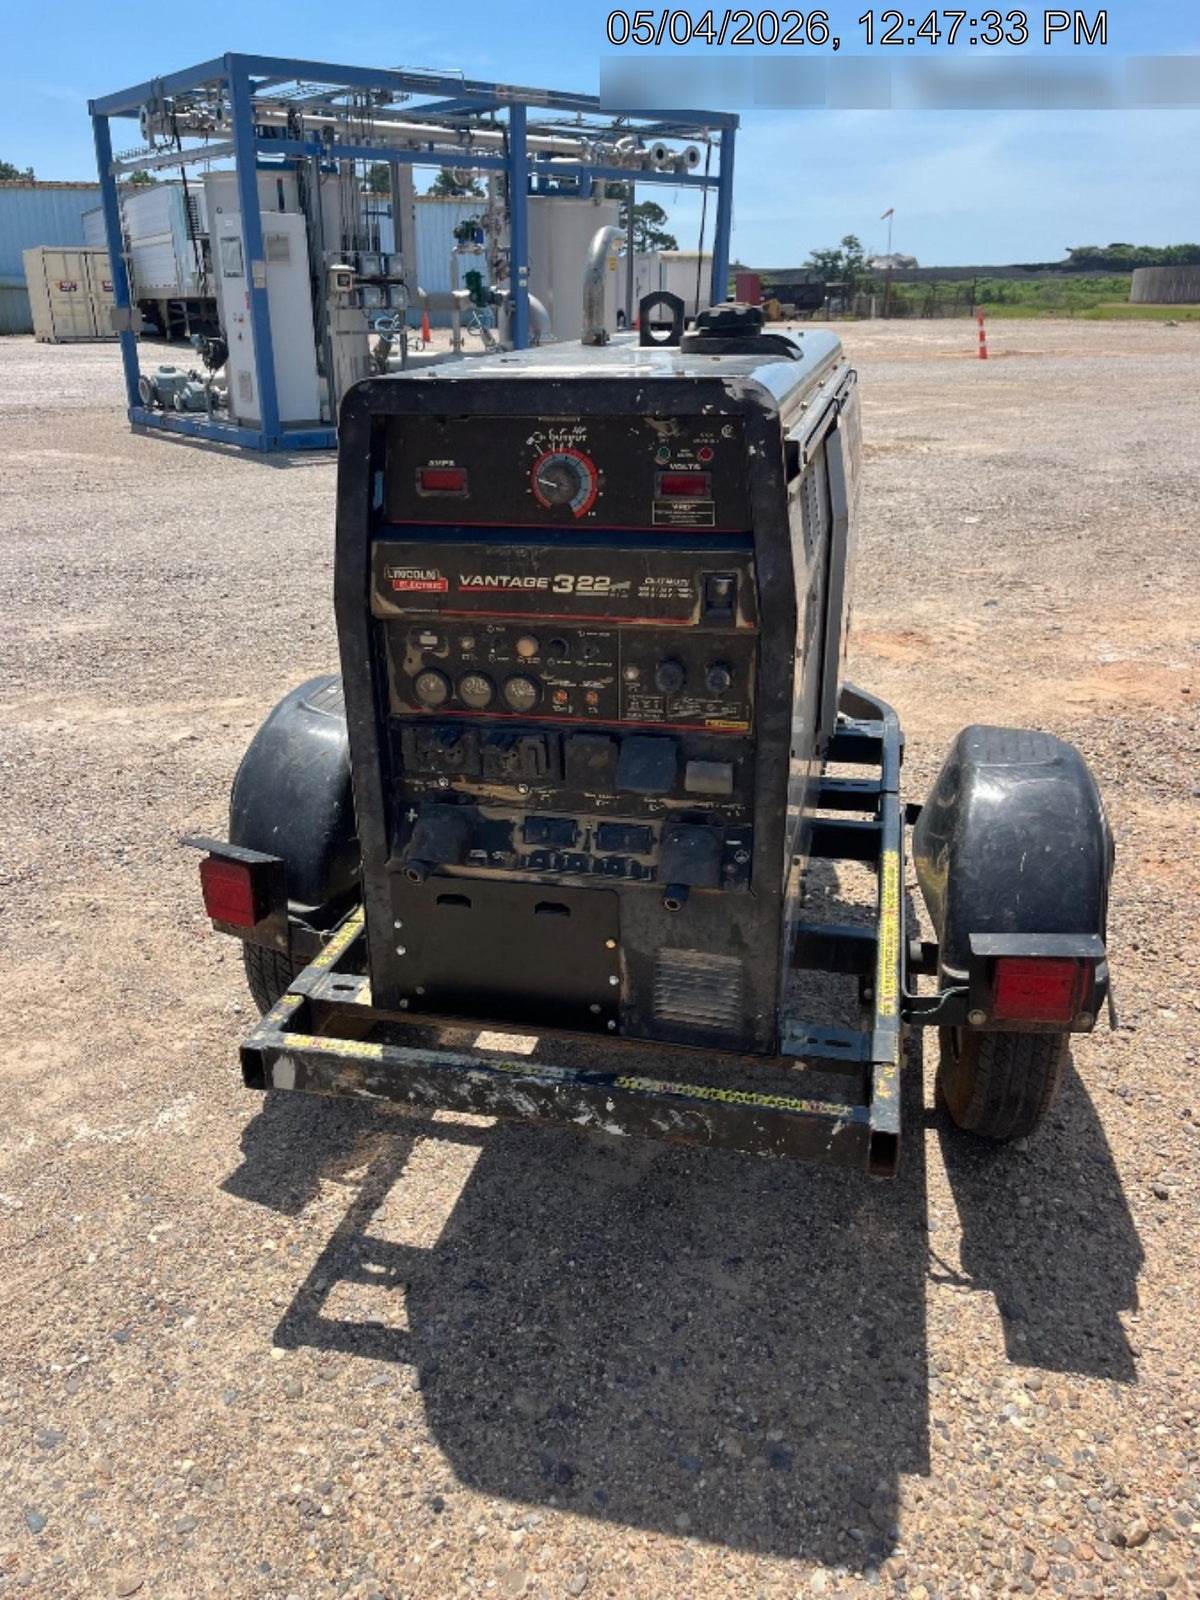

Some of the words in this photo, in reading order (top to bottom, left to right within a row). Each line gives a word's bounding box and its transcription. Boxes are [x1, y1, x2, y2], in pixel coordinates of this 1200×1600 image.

[386, 568, 437, 580] LINCOLN
[399, 580, 443, 590] ELECTRIC
[458, 574, 549, 588] VANTAGE
[552, 574, 611, 593] 322
